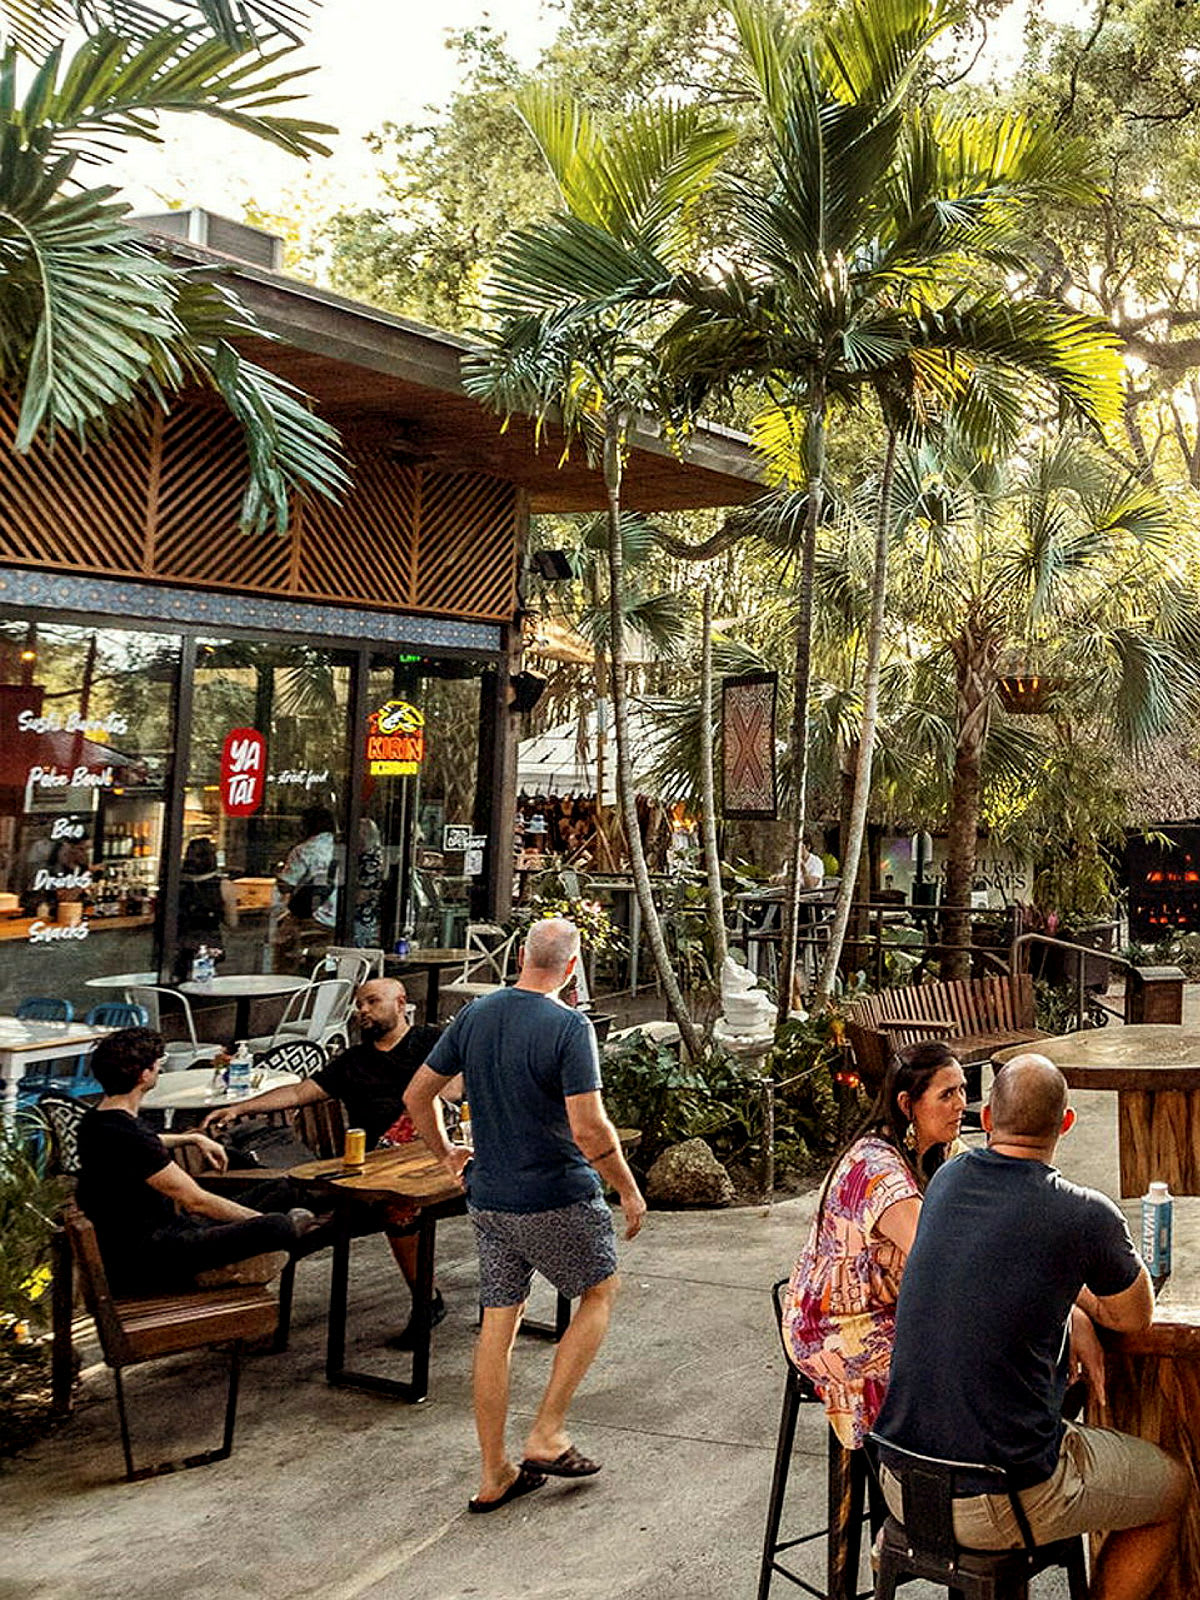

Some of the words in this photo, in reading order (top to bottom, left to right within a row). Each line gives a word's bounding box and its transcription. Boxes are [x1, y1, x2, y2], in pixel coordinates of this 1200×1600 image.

[229, 738, 260, 772] YA
[367, 736, 423, 761] KIRIN
[71, 766, 113, 787] Bowl
[228, 774, 256, 805] TAI
[33, 866, 93, 890] Drinks
[29, 920, 90, 942] Snacks
